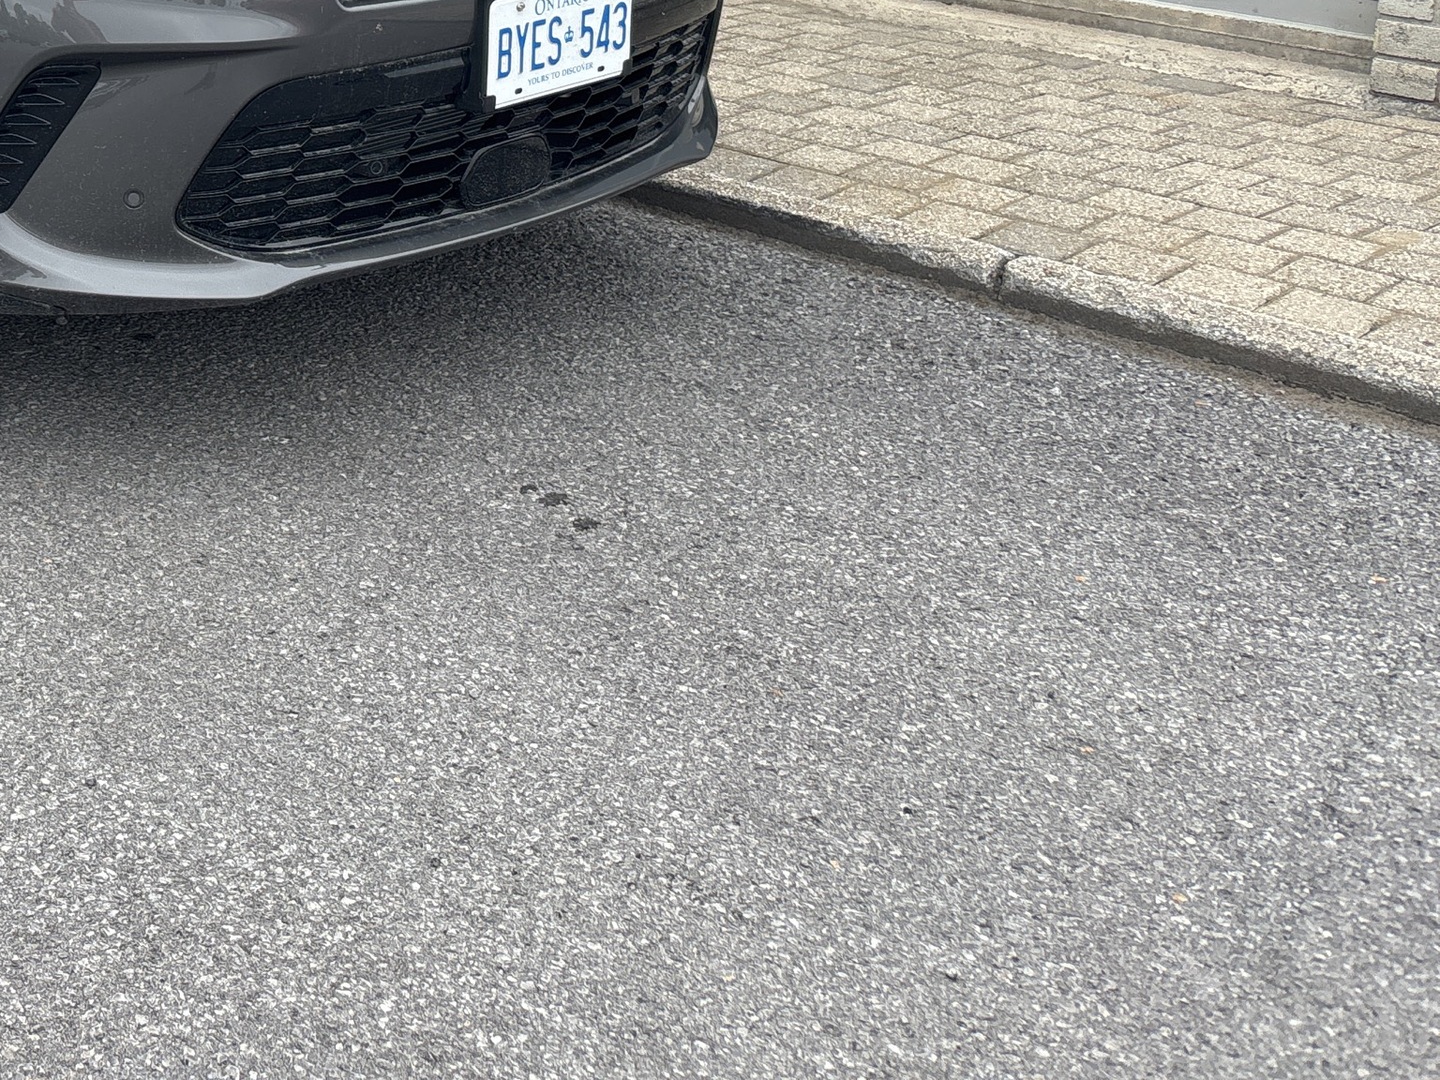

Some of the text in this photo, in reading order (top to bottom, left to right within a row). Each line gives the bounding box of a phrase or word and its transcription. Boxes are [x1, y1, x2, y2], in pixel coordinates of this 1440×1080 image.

[496, 1, 628, 80] BYES 543
[527, 61, 594, 86] YOURS TO DISCOVER
